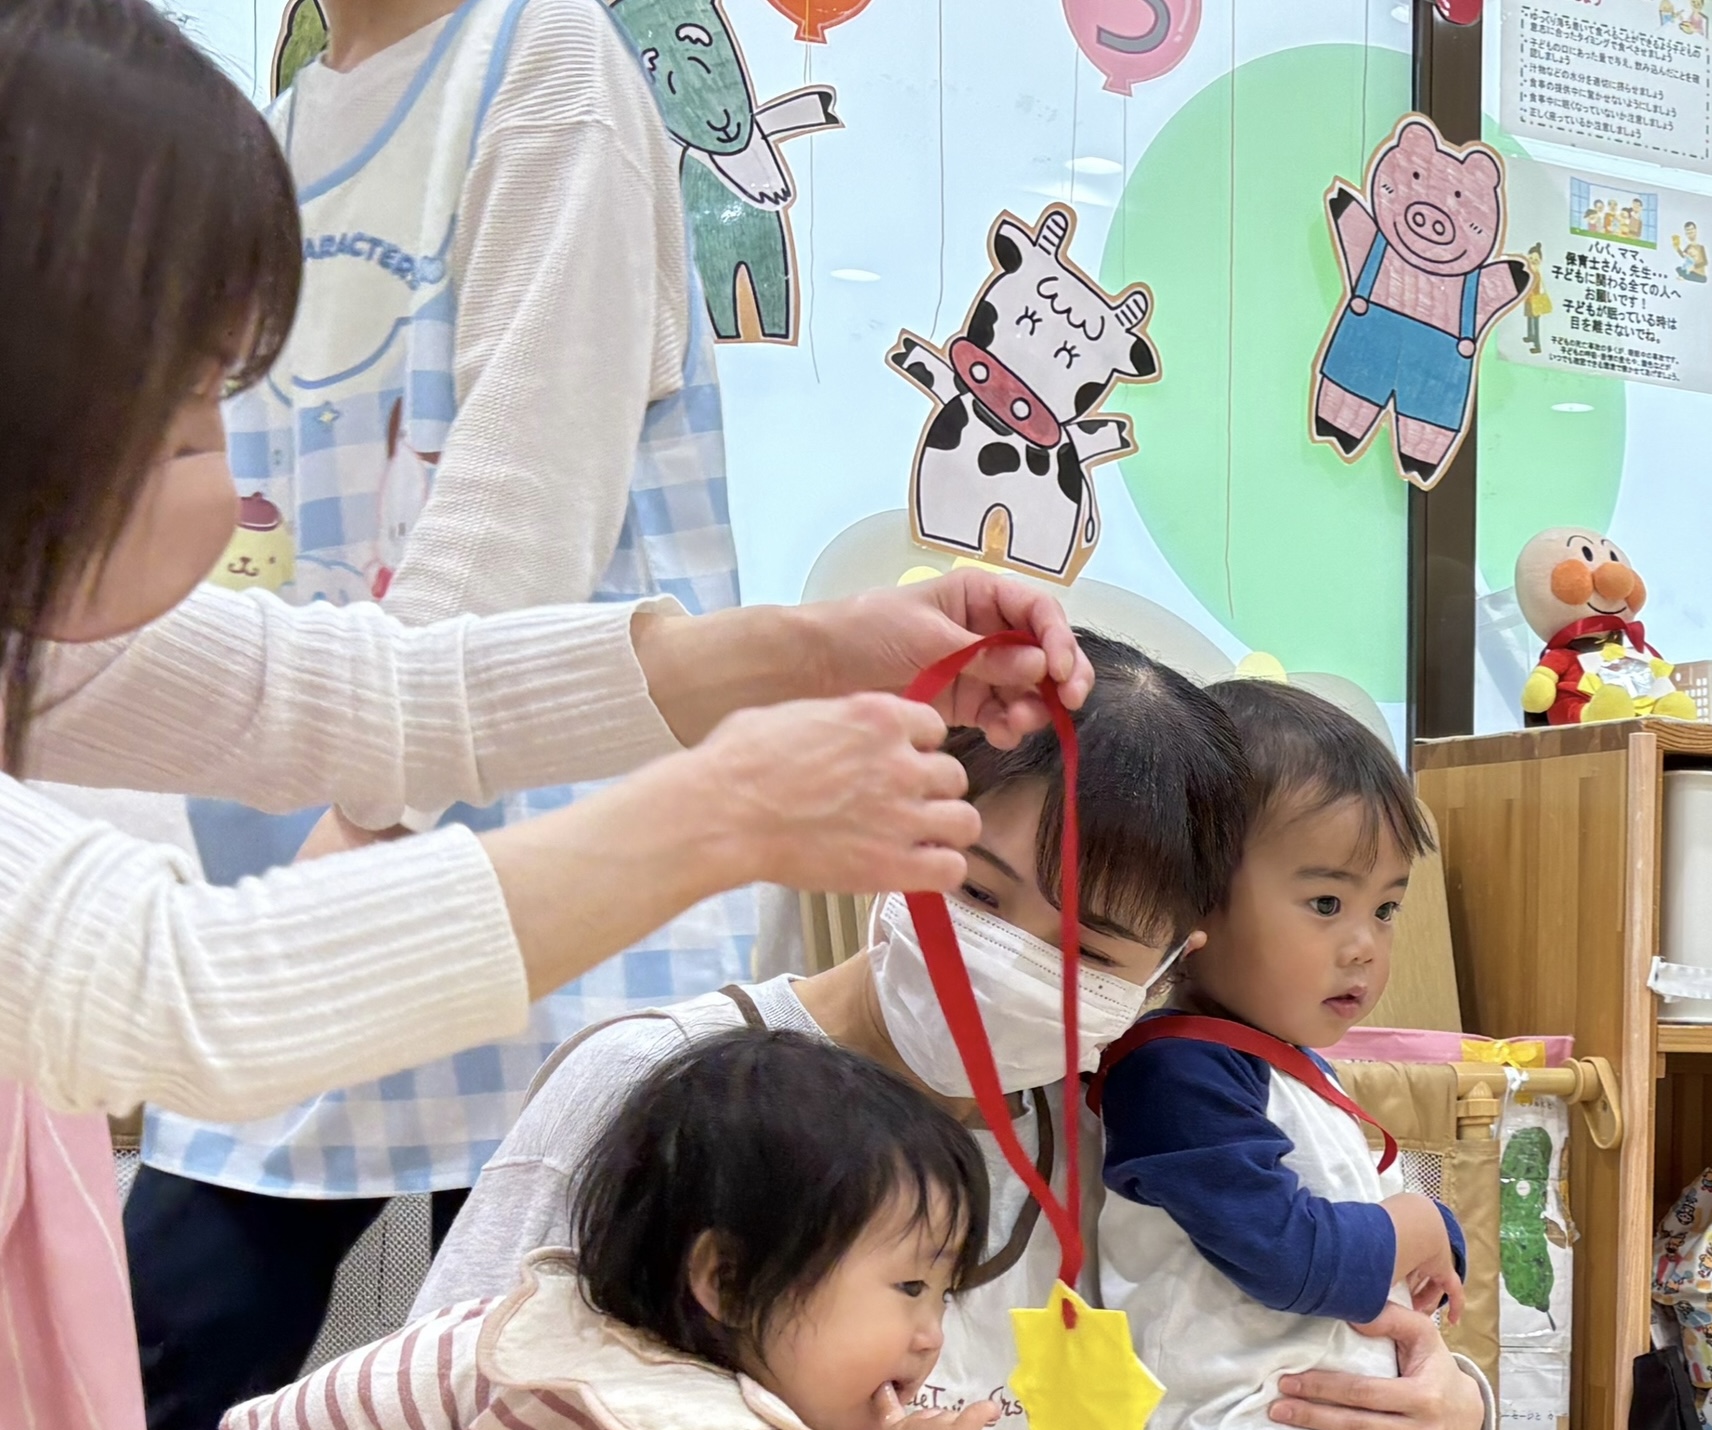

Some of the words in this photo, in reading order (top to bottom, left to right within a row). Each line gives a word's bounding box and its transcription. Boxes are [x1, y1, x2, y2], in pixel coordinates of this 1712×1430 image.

[1588, 241, 1645, 264] パパ、ママ、
[1551, 265, 1682, 299] 子どもに関わる全ての人へ
[1562, 299, 1678, 331] 子どもが眠っている時は
[1570, 316, 1661, 344] 目を離さないでね。
